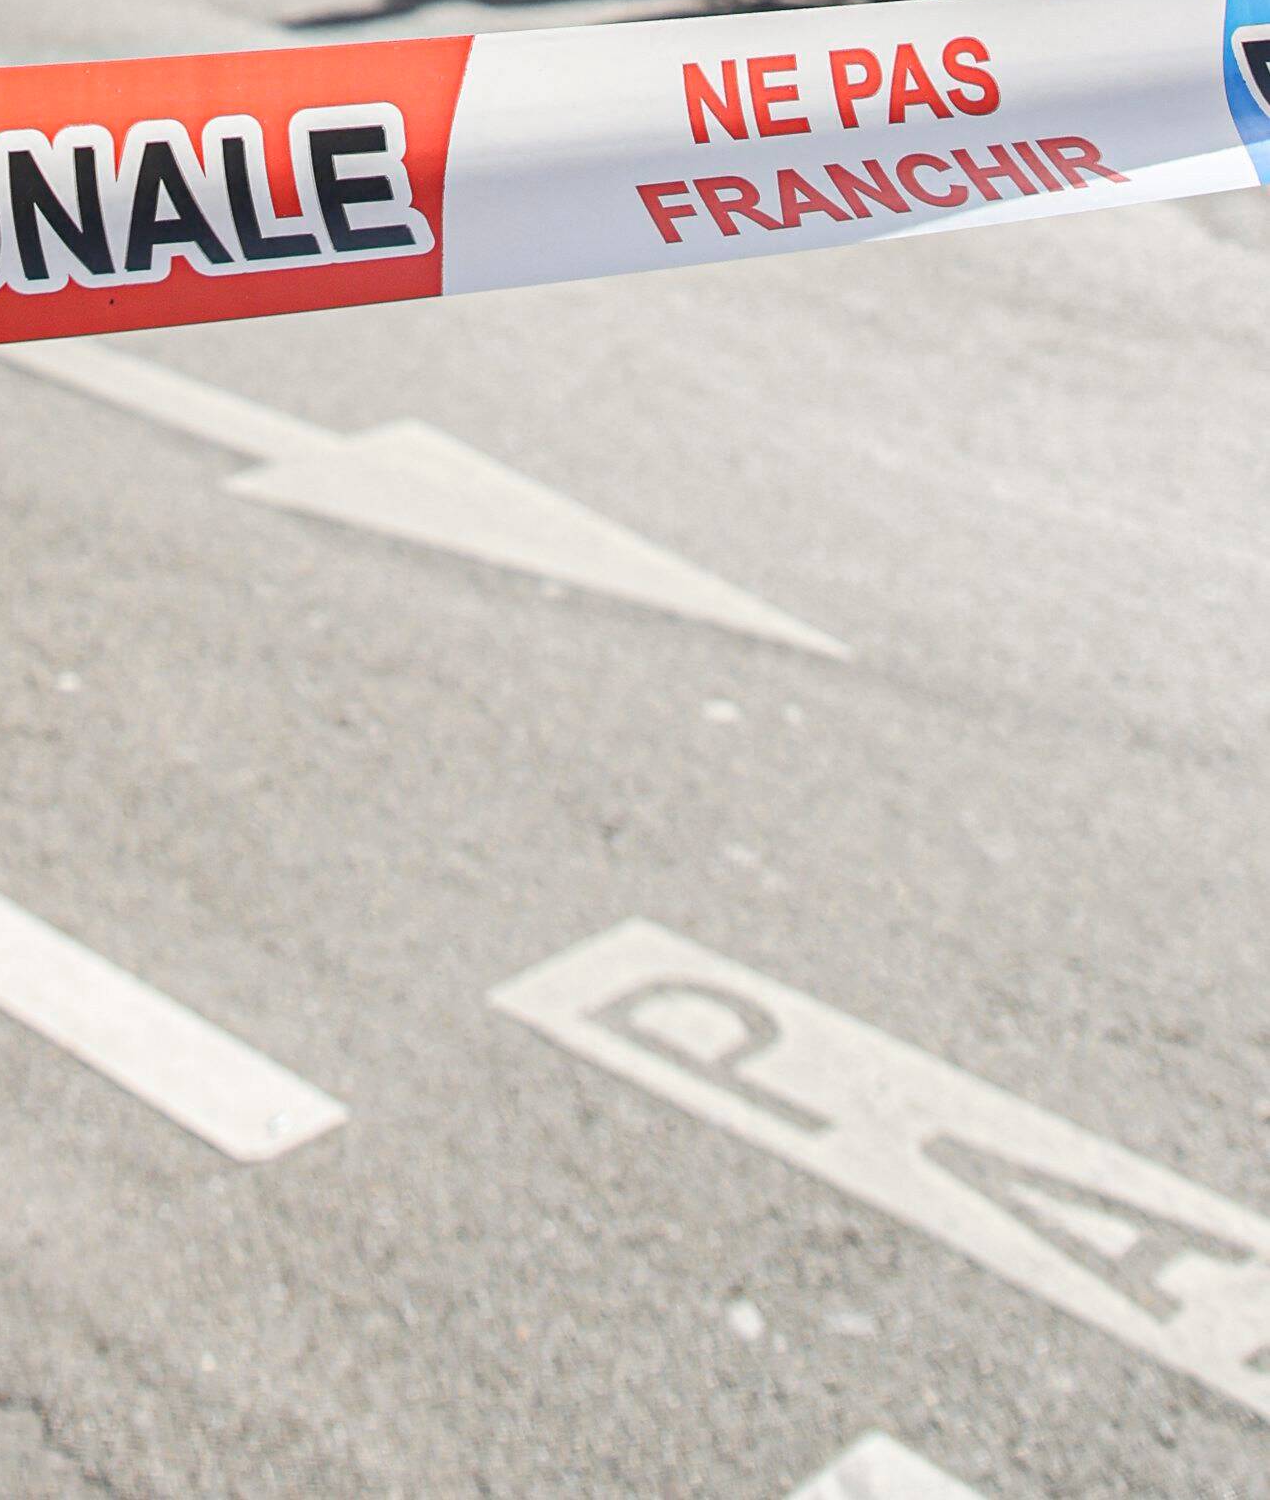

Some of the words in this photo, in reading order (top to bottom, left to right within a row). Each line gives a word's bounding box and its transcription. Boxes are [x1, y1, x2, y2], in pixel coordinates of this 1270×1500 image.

[682, 53, 812, 145] NE
[828, 35, 1002, 130] PAS
[635, 134, 1133, 244] FRANCHIR
[576, 974, 1270, 1374] PA
